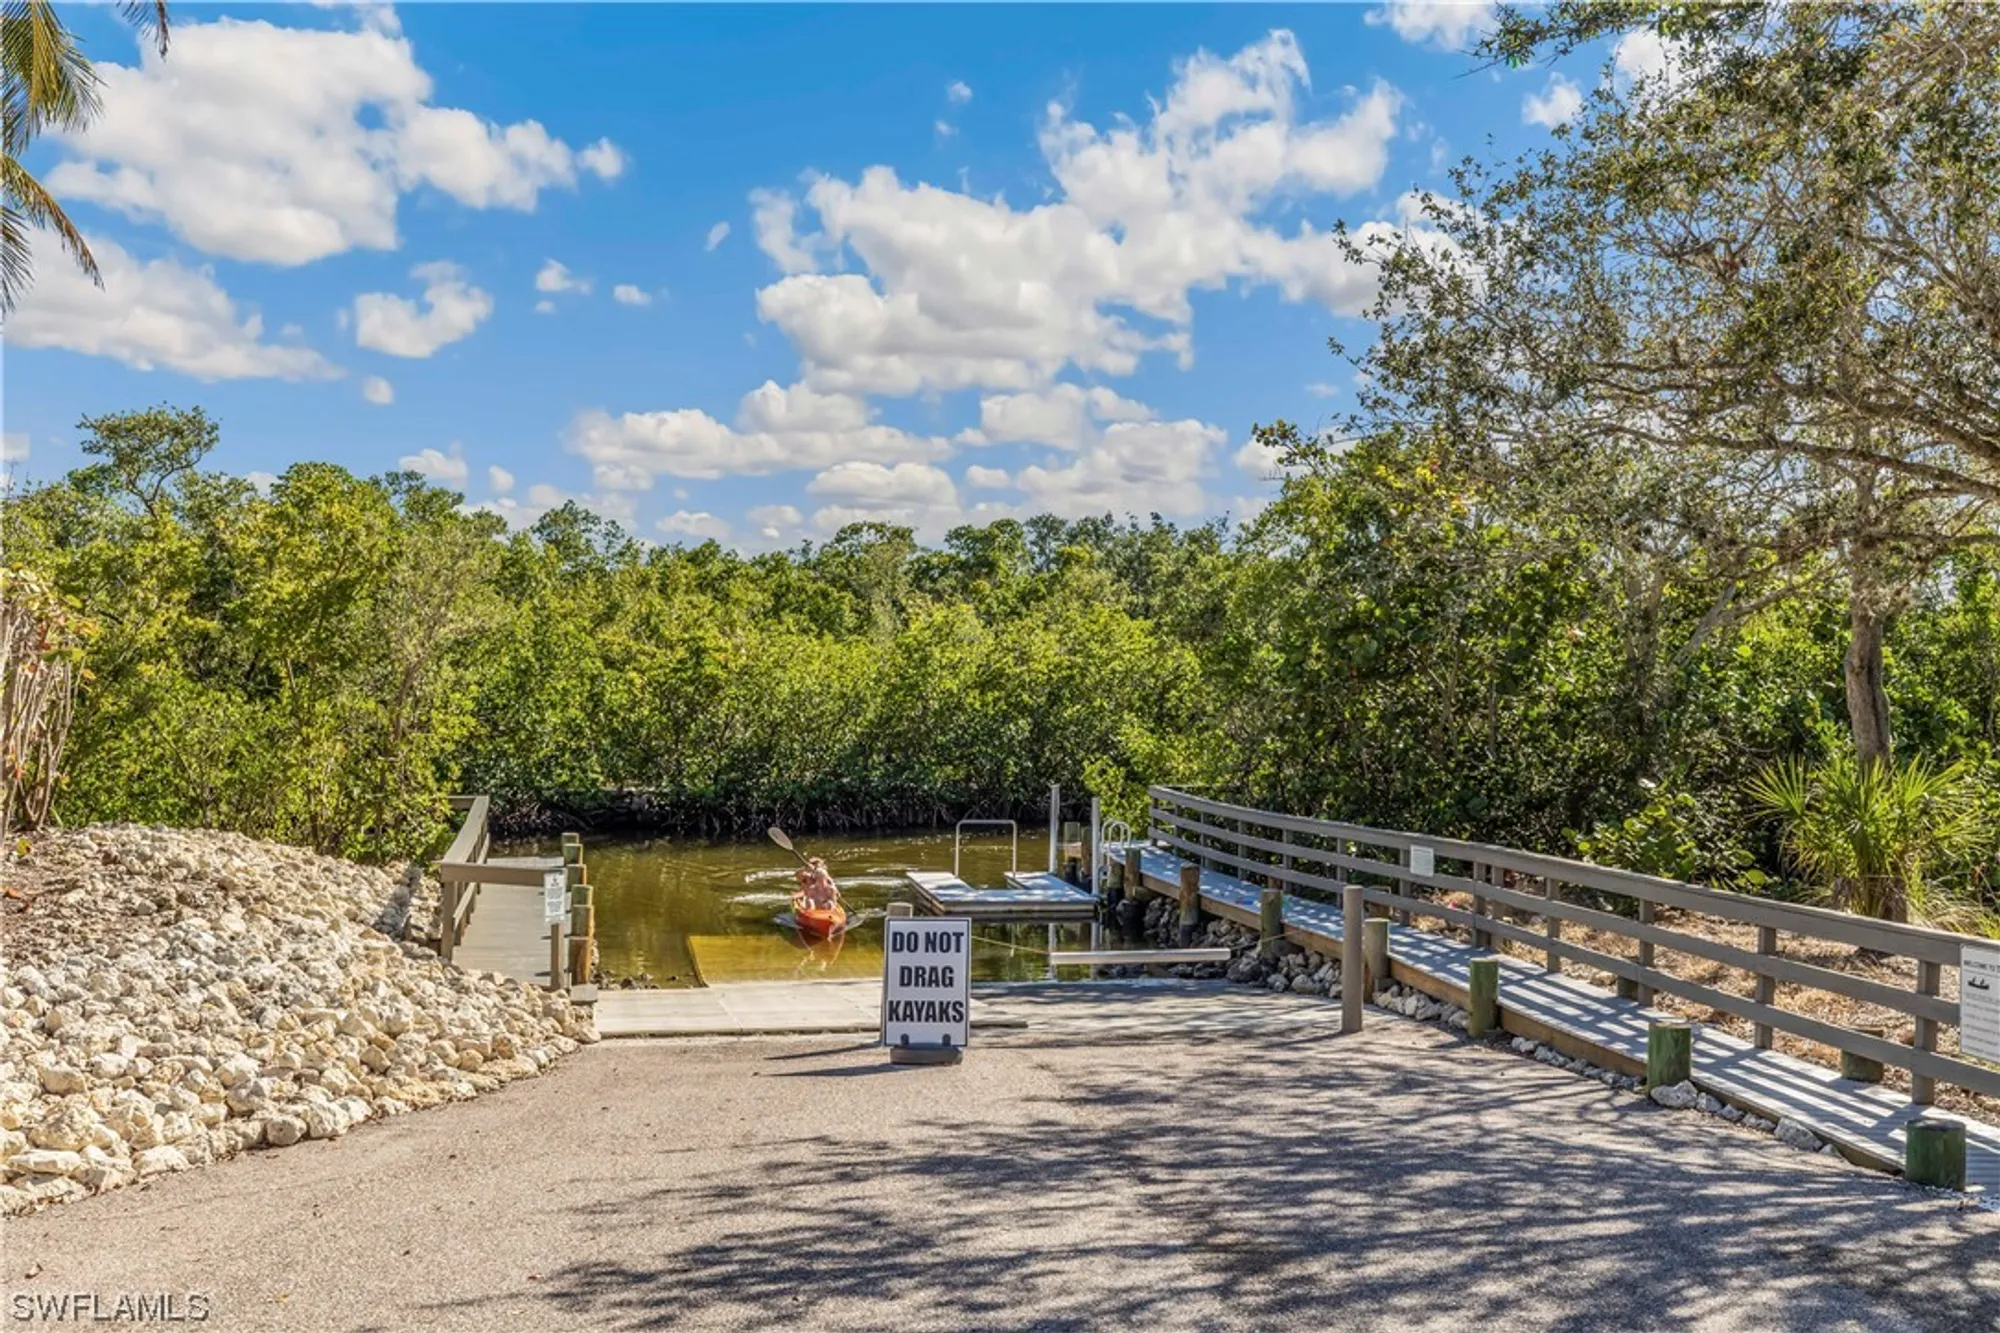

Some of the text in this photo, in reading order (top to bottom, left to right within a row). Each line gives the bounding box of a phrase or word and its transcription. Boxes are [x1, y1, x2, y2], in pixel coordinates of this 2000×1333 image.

[891, 931, 964, 953] DO NOT
[899, 966, 954, 988] DRAG
[888, 1000, 964, 1023] KAYAKS
